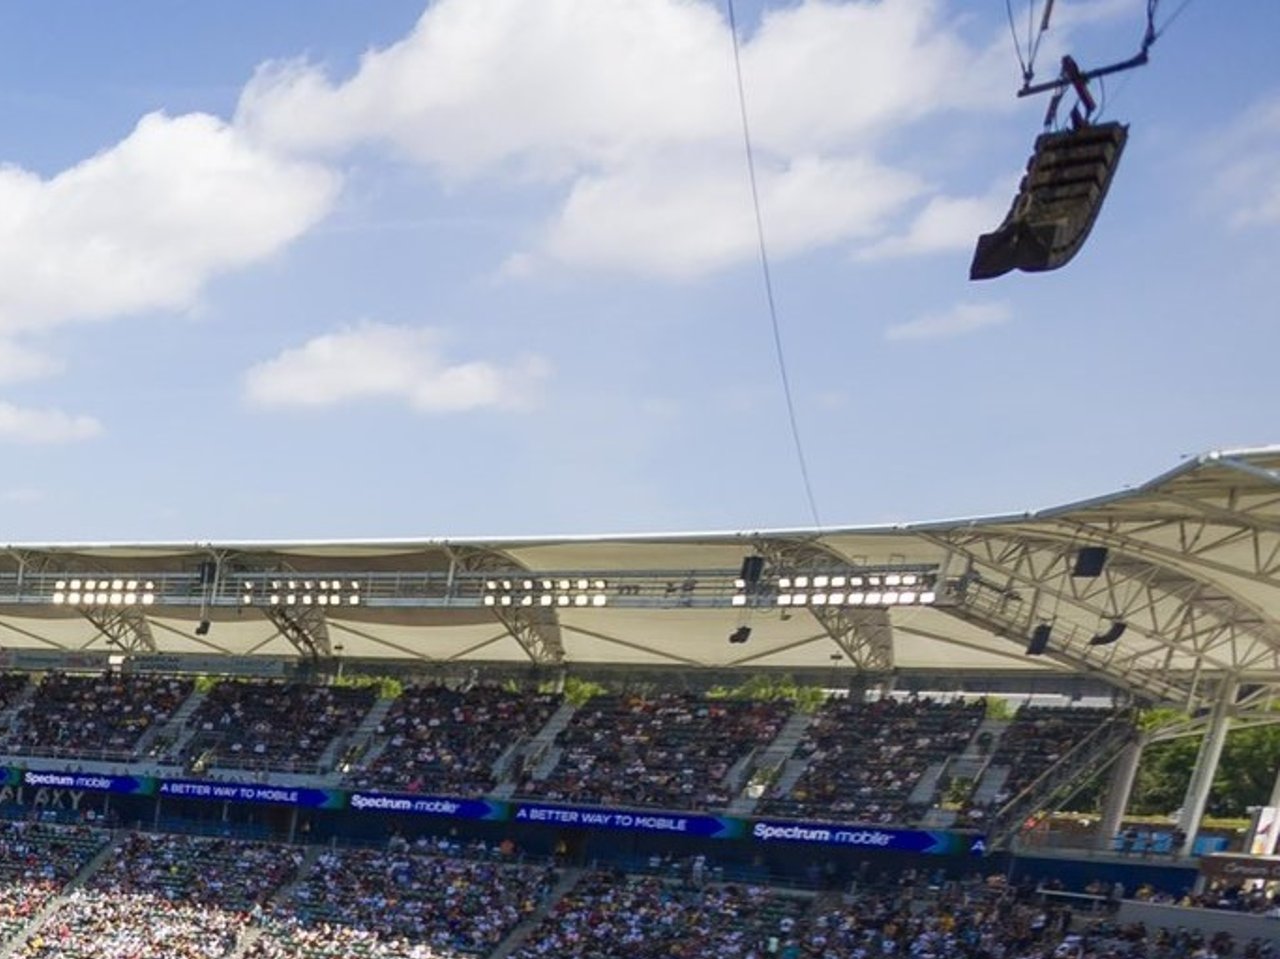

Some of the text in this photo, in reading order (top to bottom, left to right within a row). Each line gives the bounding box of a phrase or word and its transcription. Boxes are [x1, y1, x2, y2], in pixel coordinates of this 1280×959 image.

[25, 772, 113, 789] Spectrum mobile
[160, 783, 298, 802] A BETTER WAY TO MOBILE
[350, 794, 460, 813] Spectrum mobile
[516, 808, 687, 831] A BETTER WAY TO MOBILE
[753, 823, 894, 846] Spectrum mobile
[971, 840, 985, 850] A
